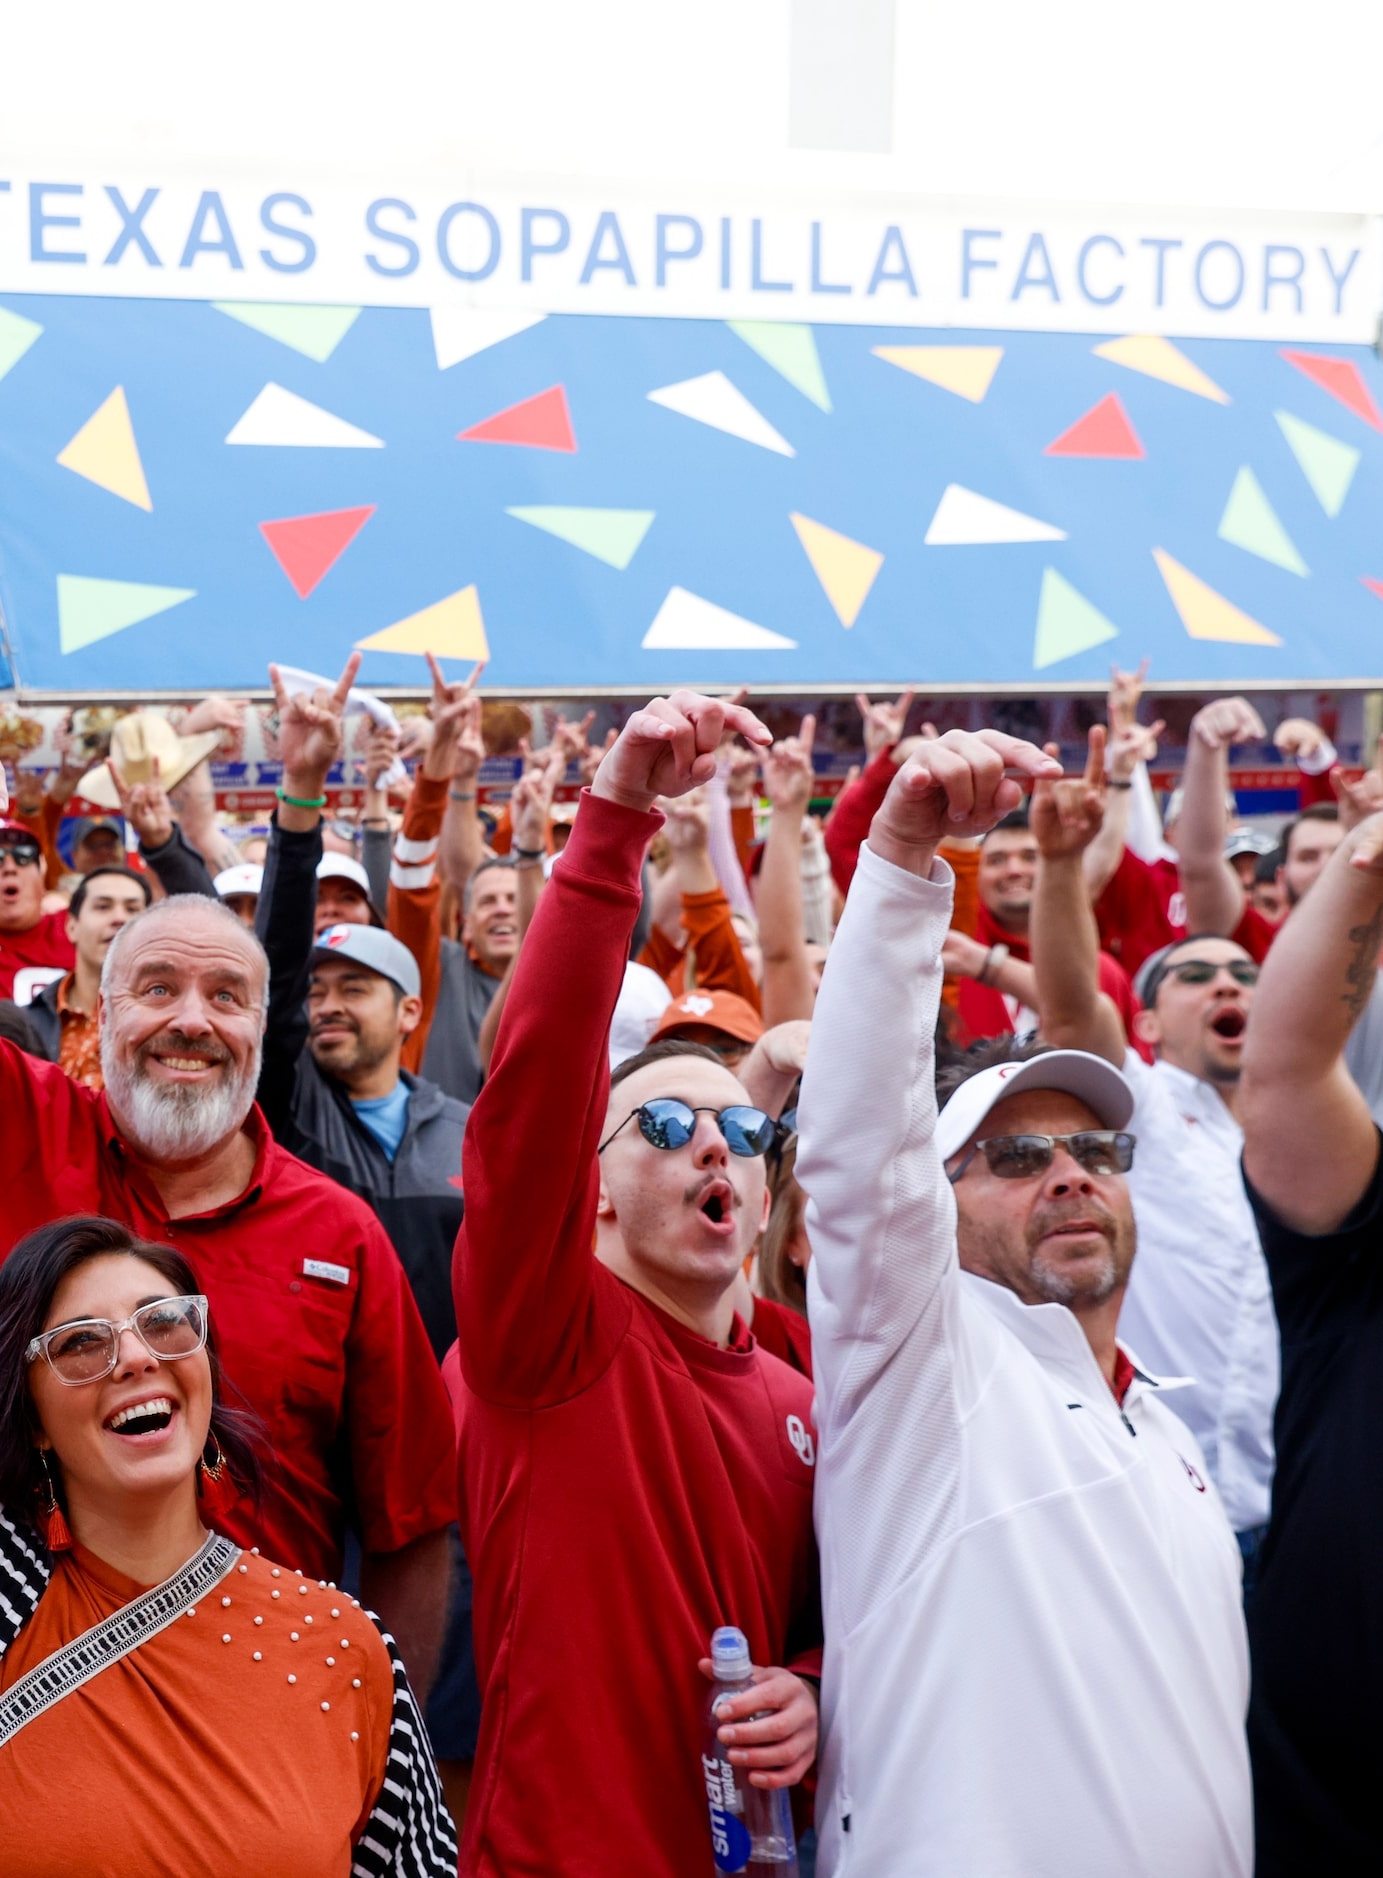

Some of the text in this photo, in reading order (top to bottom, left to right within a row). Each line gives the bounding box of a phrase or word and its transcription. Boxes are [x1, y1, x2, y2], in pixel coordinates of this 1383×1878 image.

[363, 197, 919, 299] SOPAPILLA
[960, 227, 1362, 316] FACTORY
[701, 1752, 730, 1858] smart
[719, 1759, 737, 1806] water
